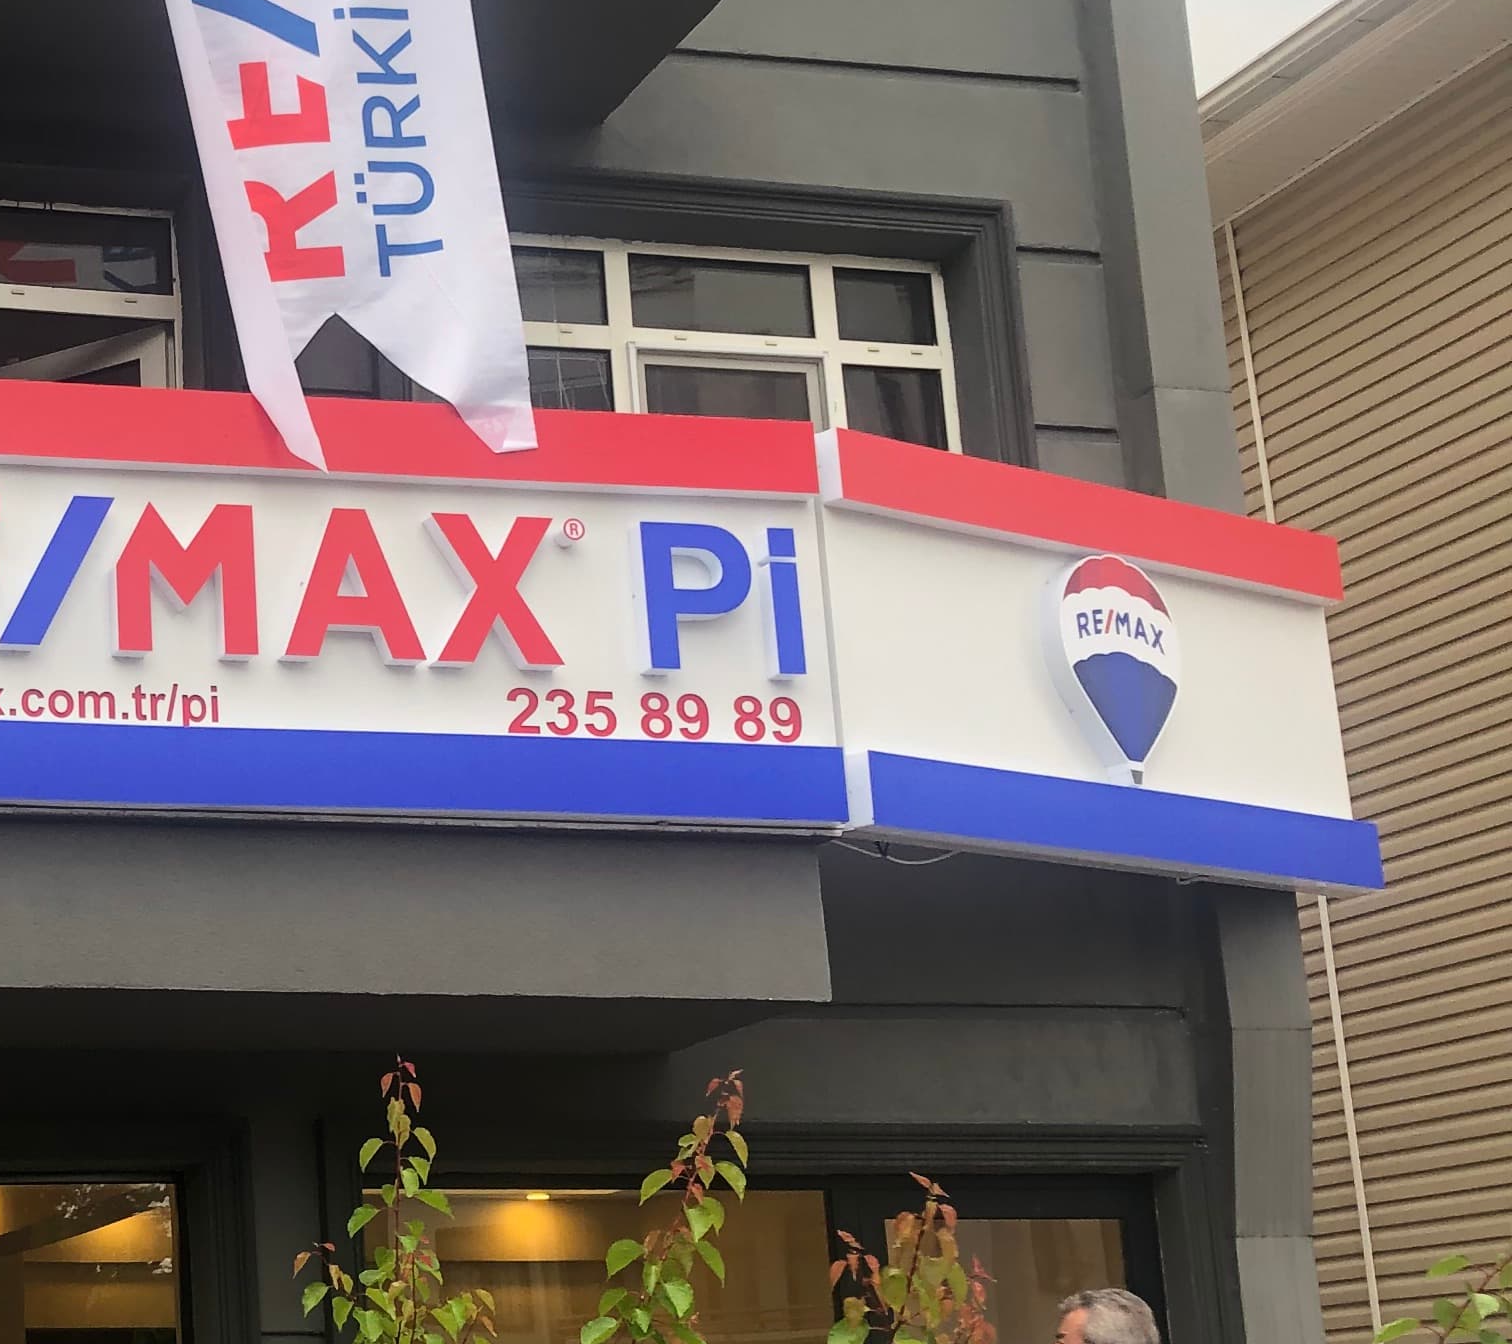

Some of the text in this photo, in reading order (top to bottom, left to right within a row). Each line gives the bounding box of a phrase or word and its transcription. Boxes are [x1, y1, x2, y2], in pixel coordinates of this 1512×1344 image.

[639, 521, 807, 675] Pi
[1076, 609, 1165, 656] RE/MAX
[506, 687, 803, 743] 235 89 89
